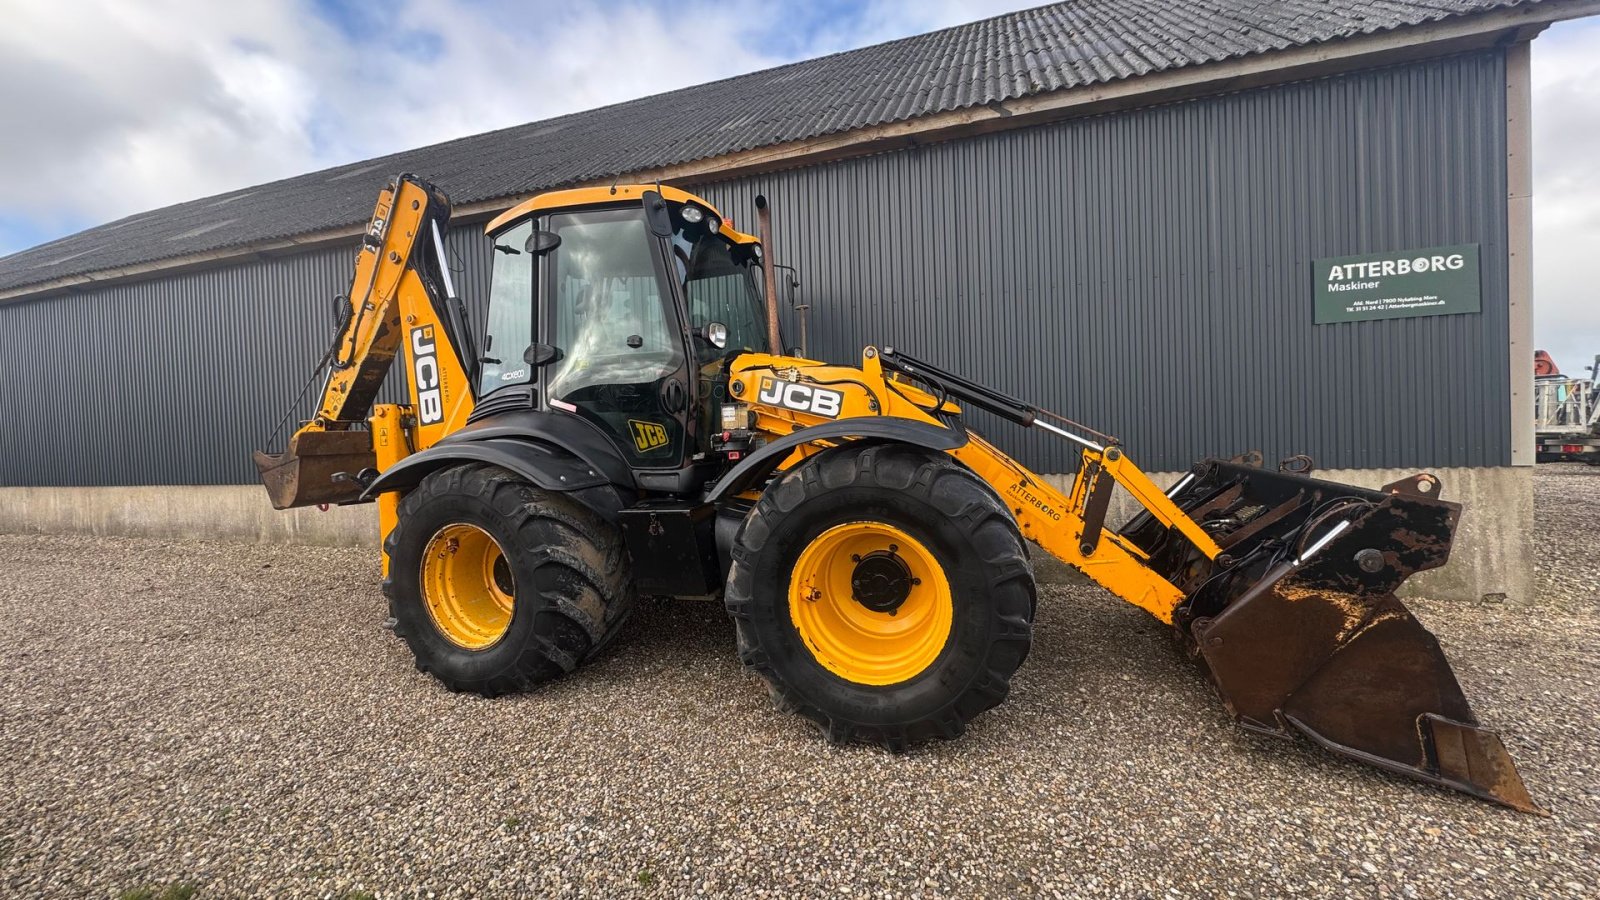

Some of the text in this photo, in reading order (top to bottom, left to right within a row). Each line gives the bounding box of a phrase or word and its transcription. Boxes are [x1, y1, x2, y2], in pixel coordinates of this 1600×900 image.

[1328, 254, 1464, 281] ATTERBORG
[1327, 281, 1380, 292] Maskiner
[412, 329, 442, 424] JCB
[760, 381, 841, 417] JCB
[635, 423, 667, 449] JCB
[1009, 483, 1061, 521] ATTERBORG
